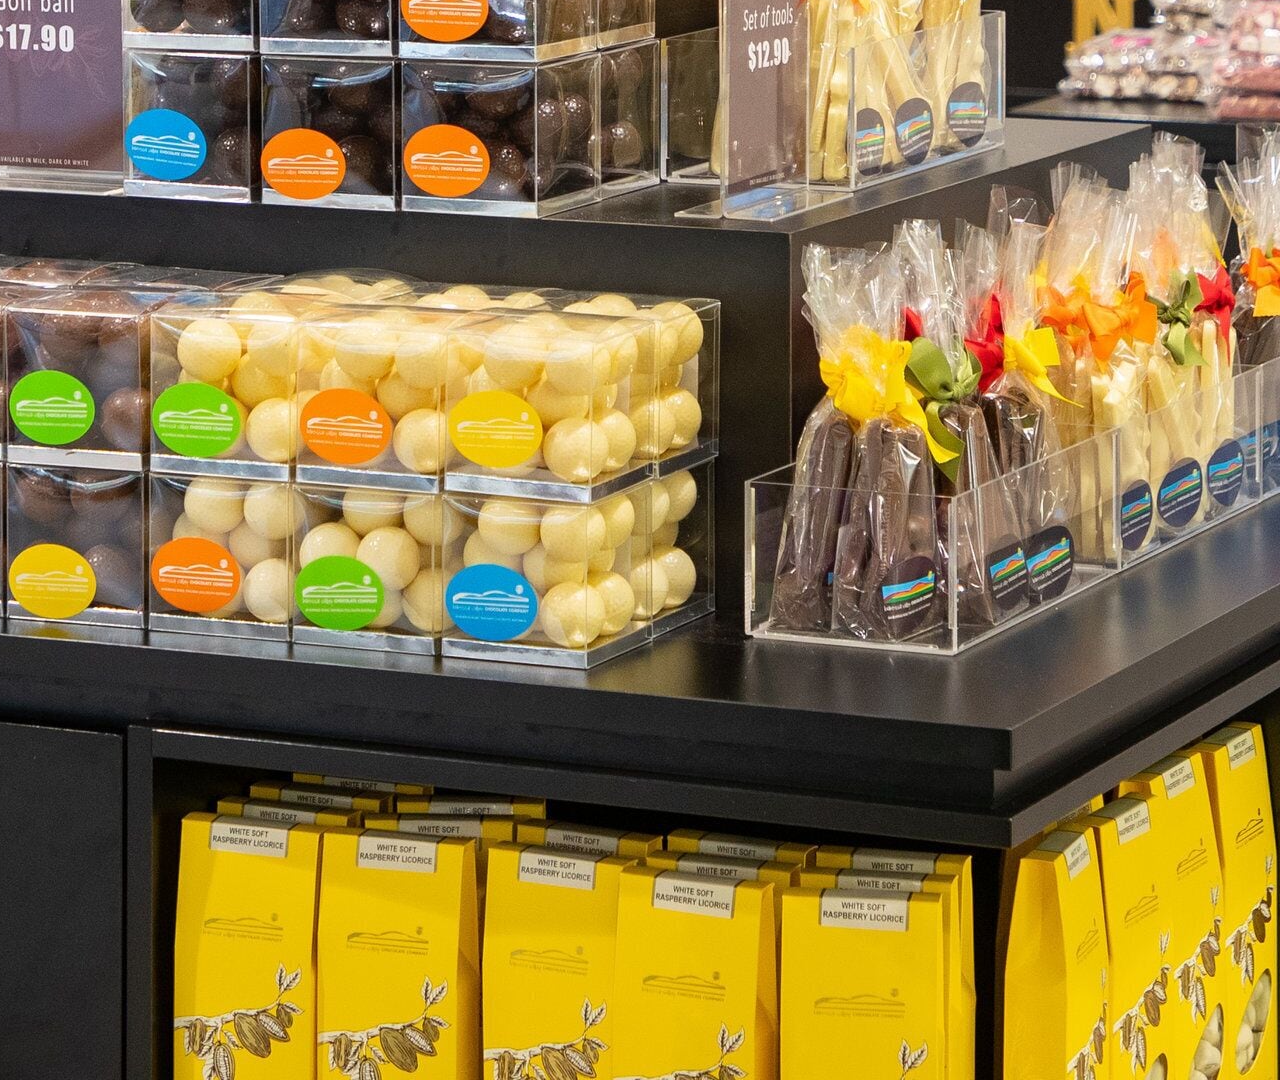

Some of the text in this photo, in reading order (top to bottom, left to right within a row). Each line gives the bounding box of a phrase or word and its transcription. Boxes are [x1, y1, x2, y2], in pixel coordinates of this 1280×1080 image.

[743, 2, 794, 32] Set of tools
[748, 37, 790, 73] $12.90
[340, 780, 378, 791] WHITE SOFT
[296, 794, 334, 806] WHITE SOFT
[259, 810, 298, 822] WHITE SOFT
[472, 807, 490, 815] SOFT
[229, 826, 269, 838] WHITE SOFT
[417, 825, 460, 834] WHITE SOFT
[212, 836, 284, 850] RASPBERRY LICORICE
[562, 833, 600, 846] WHITE SOFT
[376, 843, 417, 854] WHITE SOFT
[716, 845, 757, 857] WHITE SOFT
[359, 852, 433, 865] RASPBERRY LICORICE
[537, 858, 576, 870] WHITE SOFT
[696, 866, 738, 877] WHITE SOFT
[871, 861, 914, 871] WHITE SOFT
[520, 866, 592, 882] RASPBERRY LICORICE
[856, 879, 901, 890] WHITE SOFT
[673, 885, 714, 898] WHITE SOFT
[655, 893, 731, 911] RASPBERRY LICORICE
[841, 901, 886, 912] WHITE SOFT
[822, 910, 904, 924] RASPBERRY LICORICE
